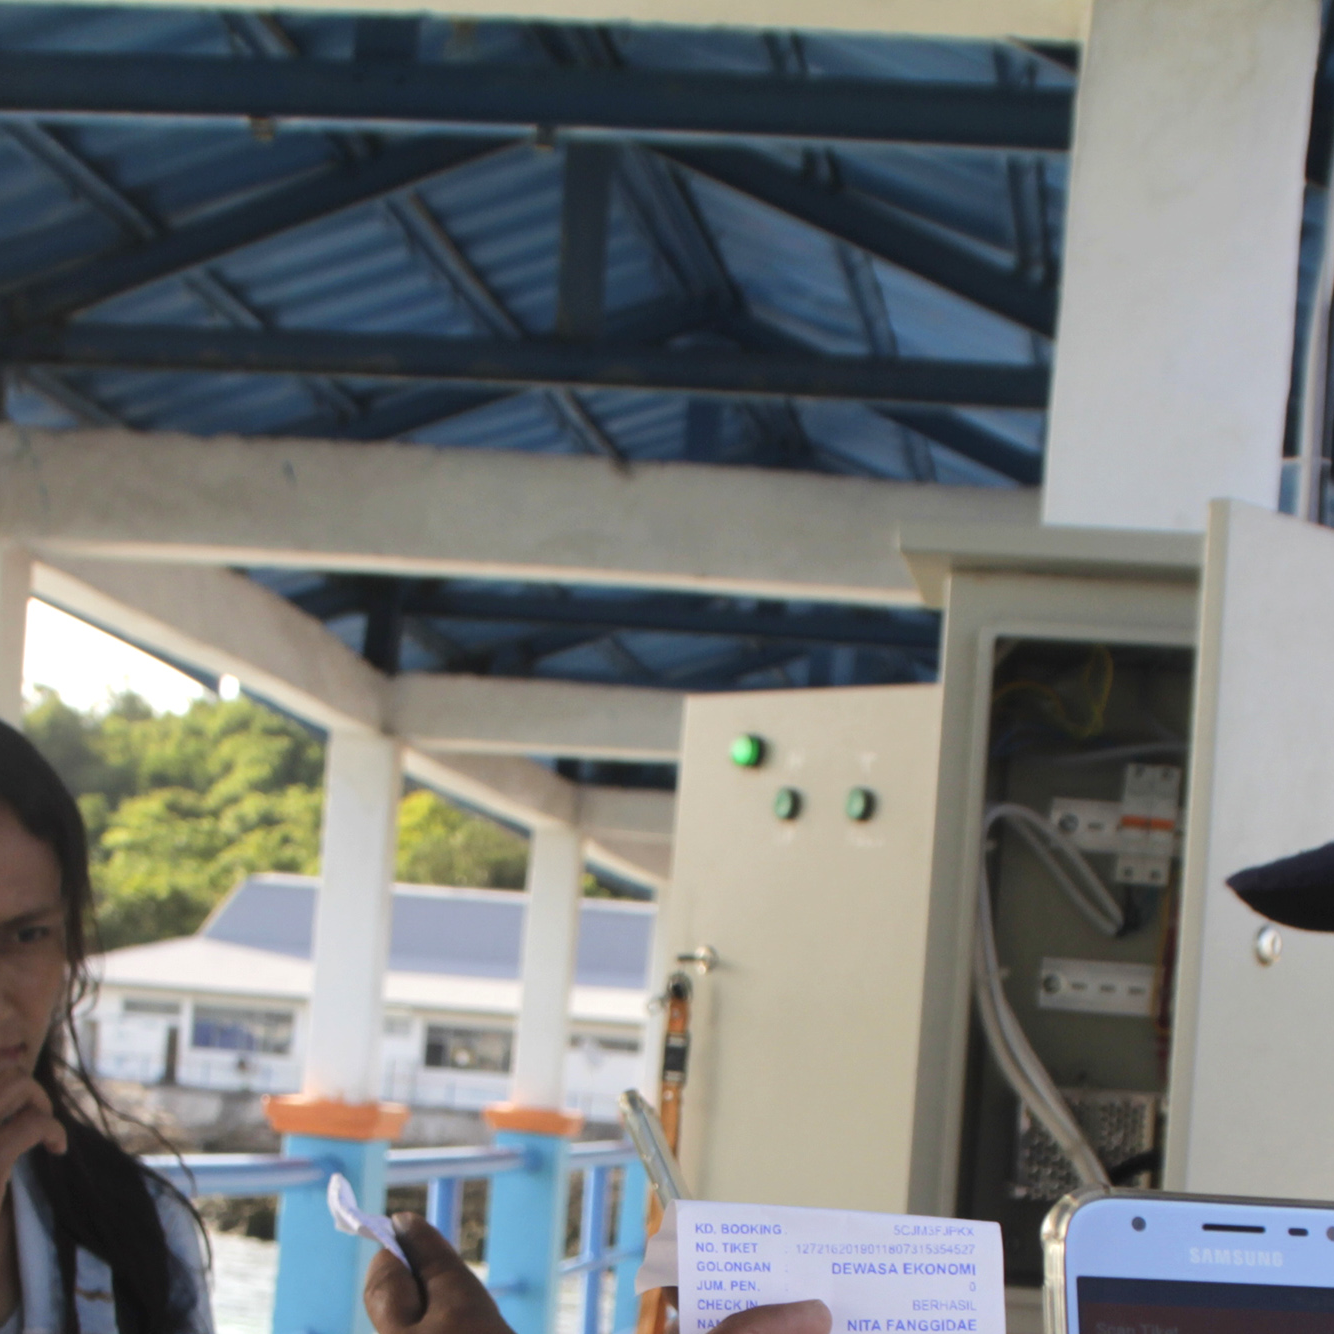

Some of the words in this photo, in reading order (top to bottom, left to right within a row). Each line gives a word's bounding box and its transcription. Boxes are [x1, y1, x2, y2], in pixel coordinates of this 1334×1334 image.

[695, 1223, 716, 1235] KD.
[721, 1224, 782, 1235] BOOKING
[695, 1242, 718, 1253] NO.
[722, 1243, 758, 1253] TIKET
[1189, 1247, 1283, 1267] SAMSUNG
[696, 1261, 771, 1272] GOLONGAN
[831, 1262, 898, 1275] DEWASA
[903, 1263, 976, 1276] EKONOMI
[696, 1280, 726, 1291] JUM.
[730, 1280, 760, 1292] PEN.
[697, 1299, 742, 1310] CHECK
[913, 1300, 977, 1311] BERHASIL
[847, 1319, 882, 1332] NITA
[886, 1319, 978, 1332] FANGGIDAE
